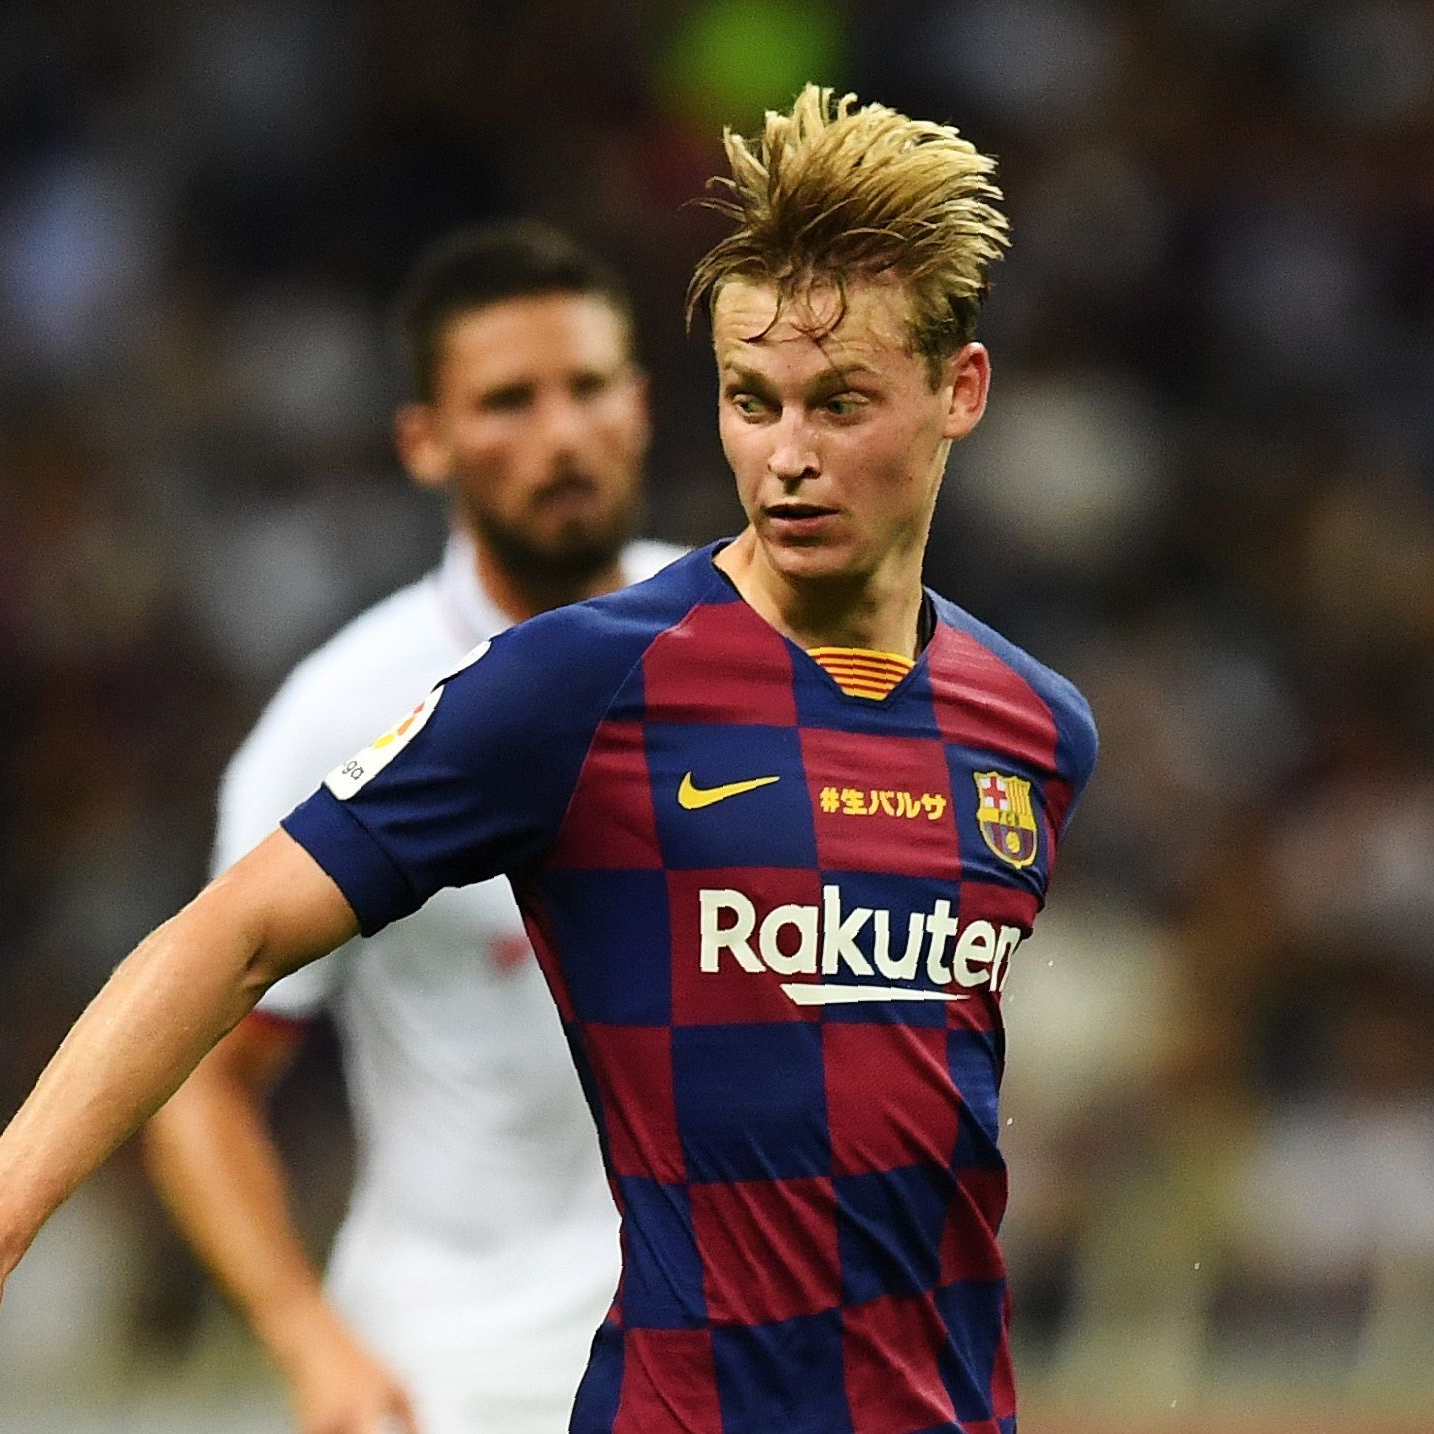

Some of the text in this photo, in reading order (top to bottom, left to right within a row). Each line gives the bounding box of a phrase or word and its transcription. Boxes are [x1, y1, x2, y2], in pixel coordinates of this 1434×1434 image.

[820, 786, 947, 821] #生バルサ
[698, 885, 1021, 992] Rakuten
